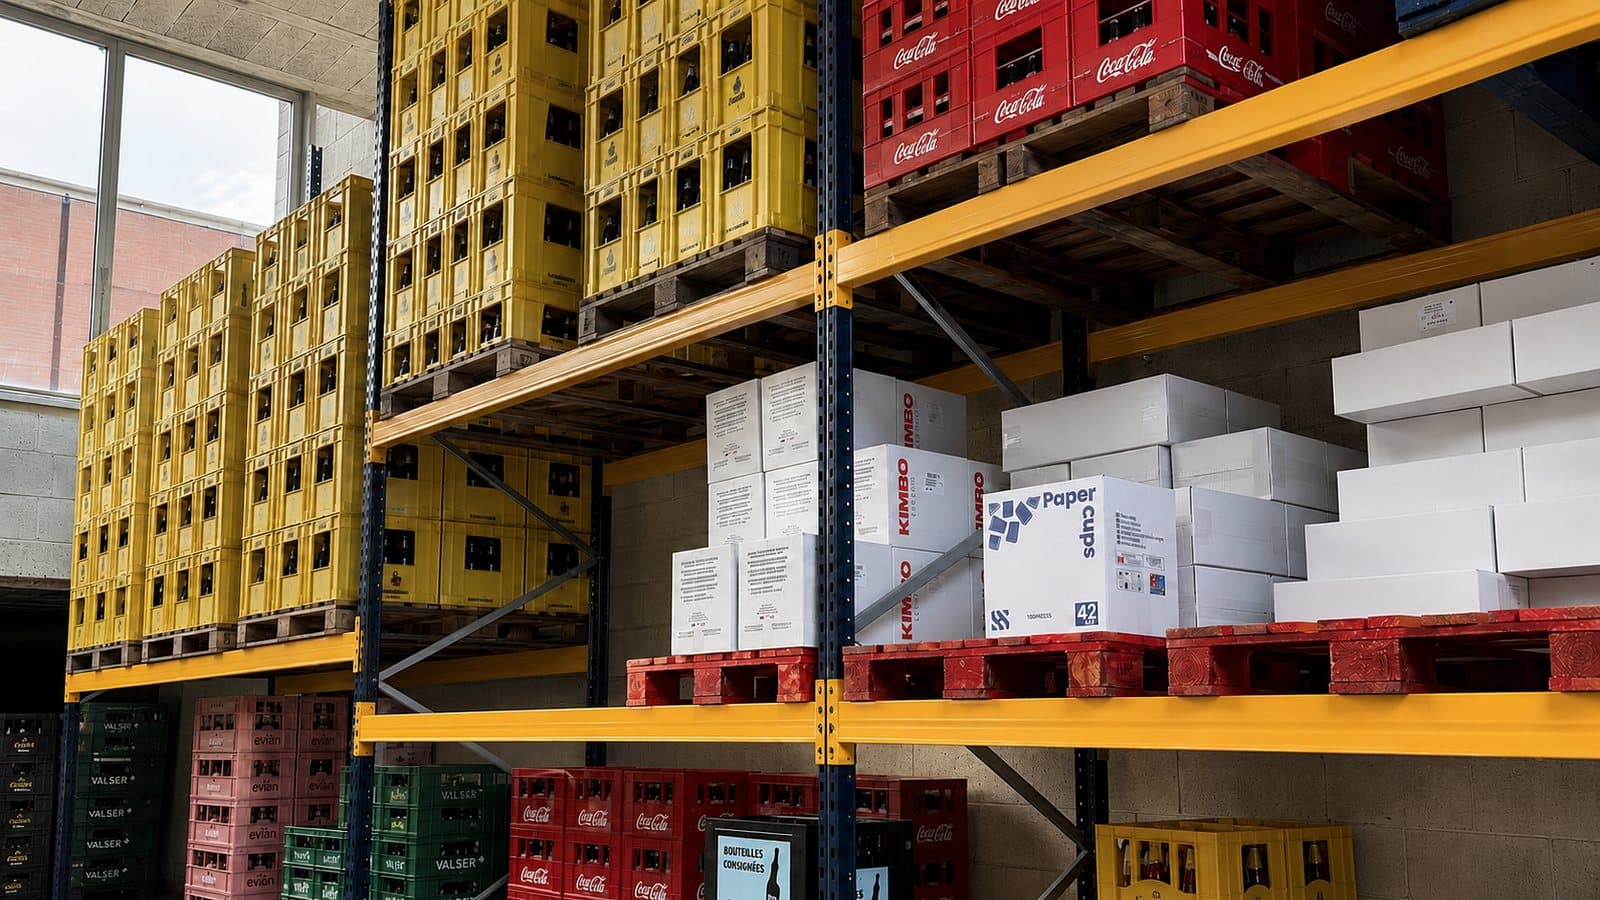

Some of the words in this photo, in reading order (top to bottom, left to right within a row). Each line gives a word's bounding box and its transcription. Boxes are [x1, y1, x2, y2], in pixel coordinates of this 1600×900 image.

[904, 393, 913, 448] IMBO
[898, 458, 909, 536] KIMBO
[974, 471, 984, 530] IMBO
[1043, 487, 1096, 509] Paper
[1079, 505, 1095, 559] cups
[900, 560, 912, 640] KIMO
[1077, 603, 1096, 620] 42
[254, 734, 280, 745] evian
[91, 776, 128, 785] VALSER
[252, 780, 278, 792] evian
[89, 809, 125, 818] VALSER
[249, 827, 276, 840] evian
[86, 840, 122, 849] VALSER
[723, 846, 763, 859] BOUTEILLES
[436, 857, 477, 871] VALSER
[723, 859, 765, 874] CONSIGNÉES
[85, 869, 120, 879] VALSER
[247, 874, 274, 888] evian
